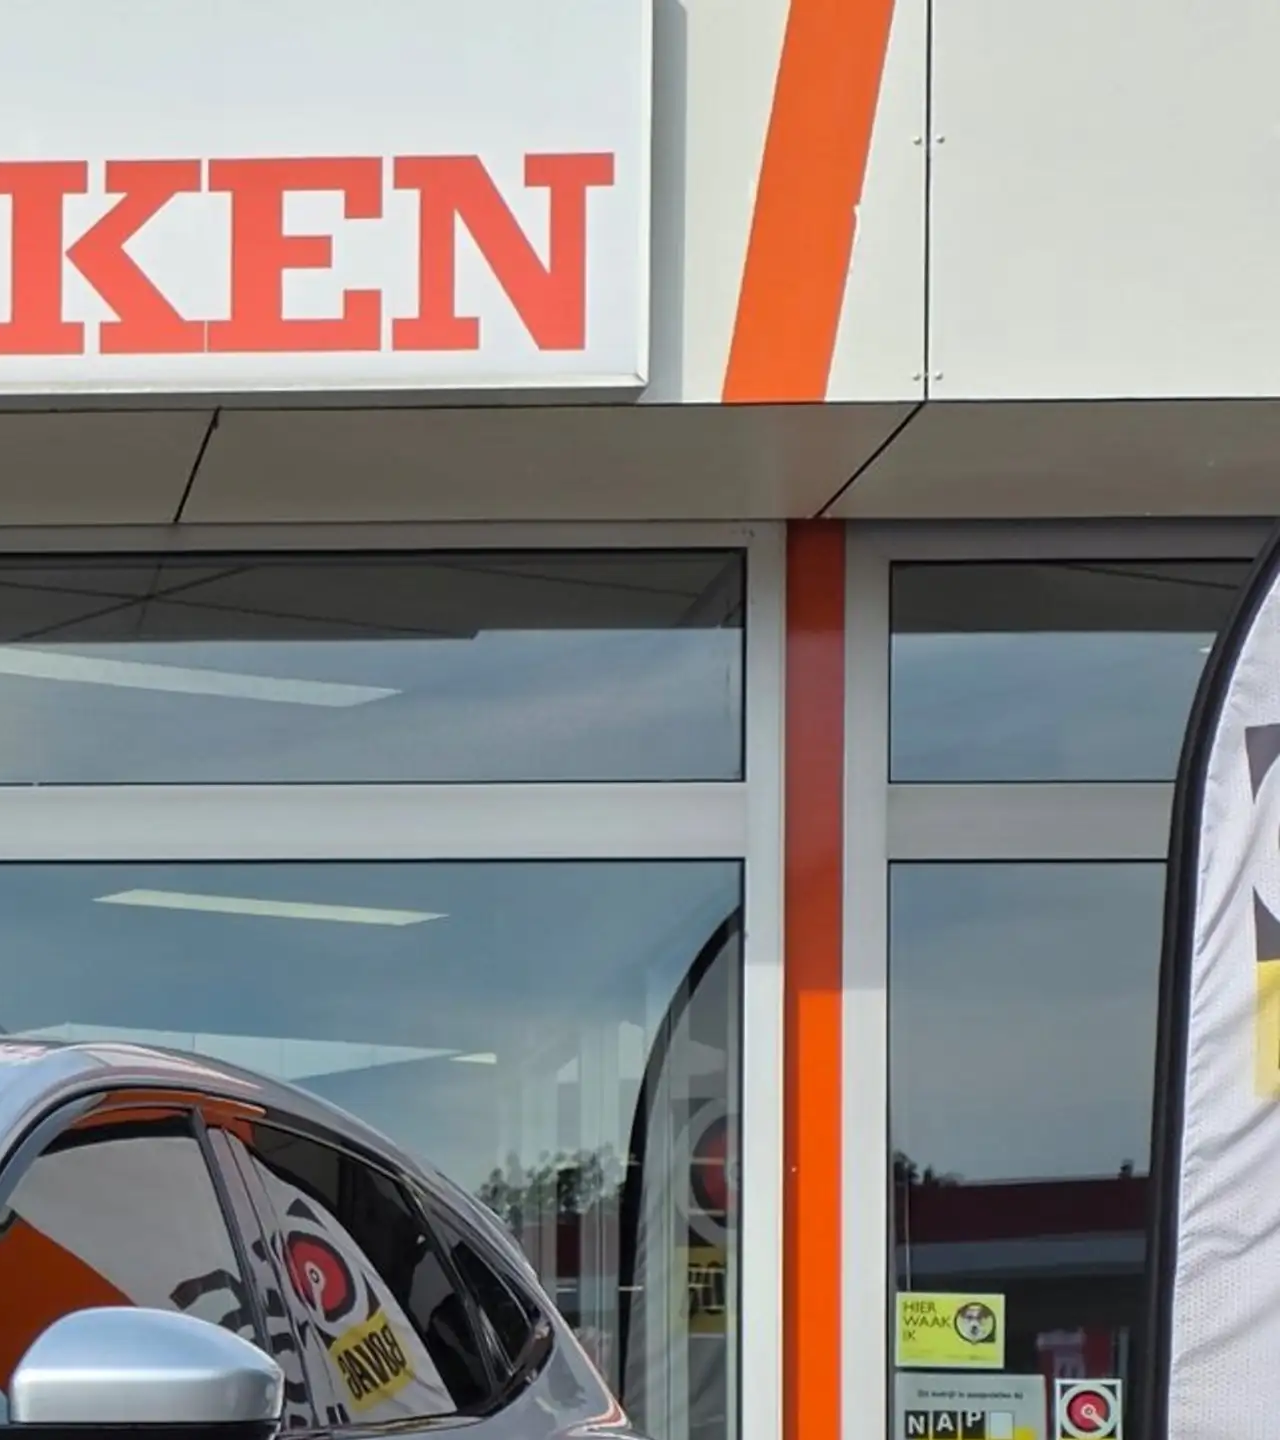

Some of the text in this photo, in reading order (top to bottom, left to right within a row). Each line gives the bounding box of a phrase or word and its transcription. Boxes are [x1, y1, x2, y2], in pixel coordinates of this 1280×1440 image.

[902, 1301, 937, 1314] HIER
[902, 1315, 952, 1329] WAAK
[902, 1330, 916, 1342] IK
[907, 1410, 983, 1435] NAP
